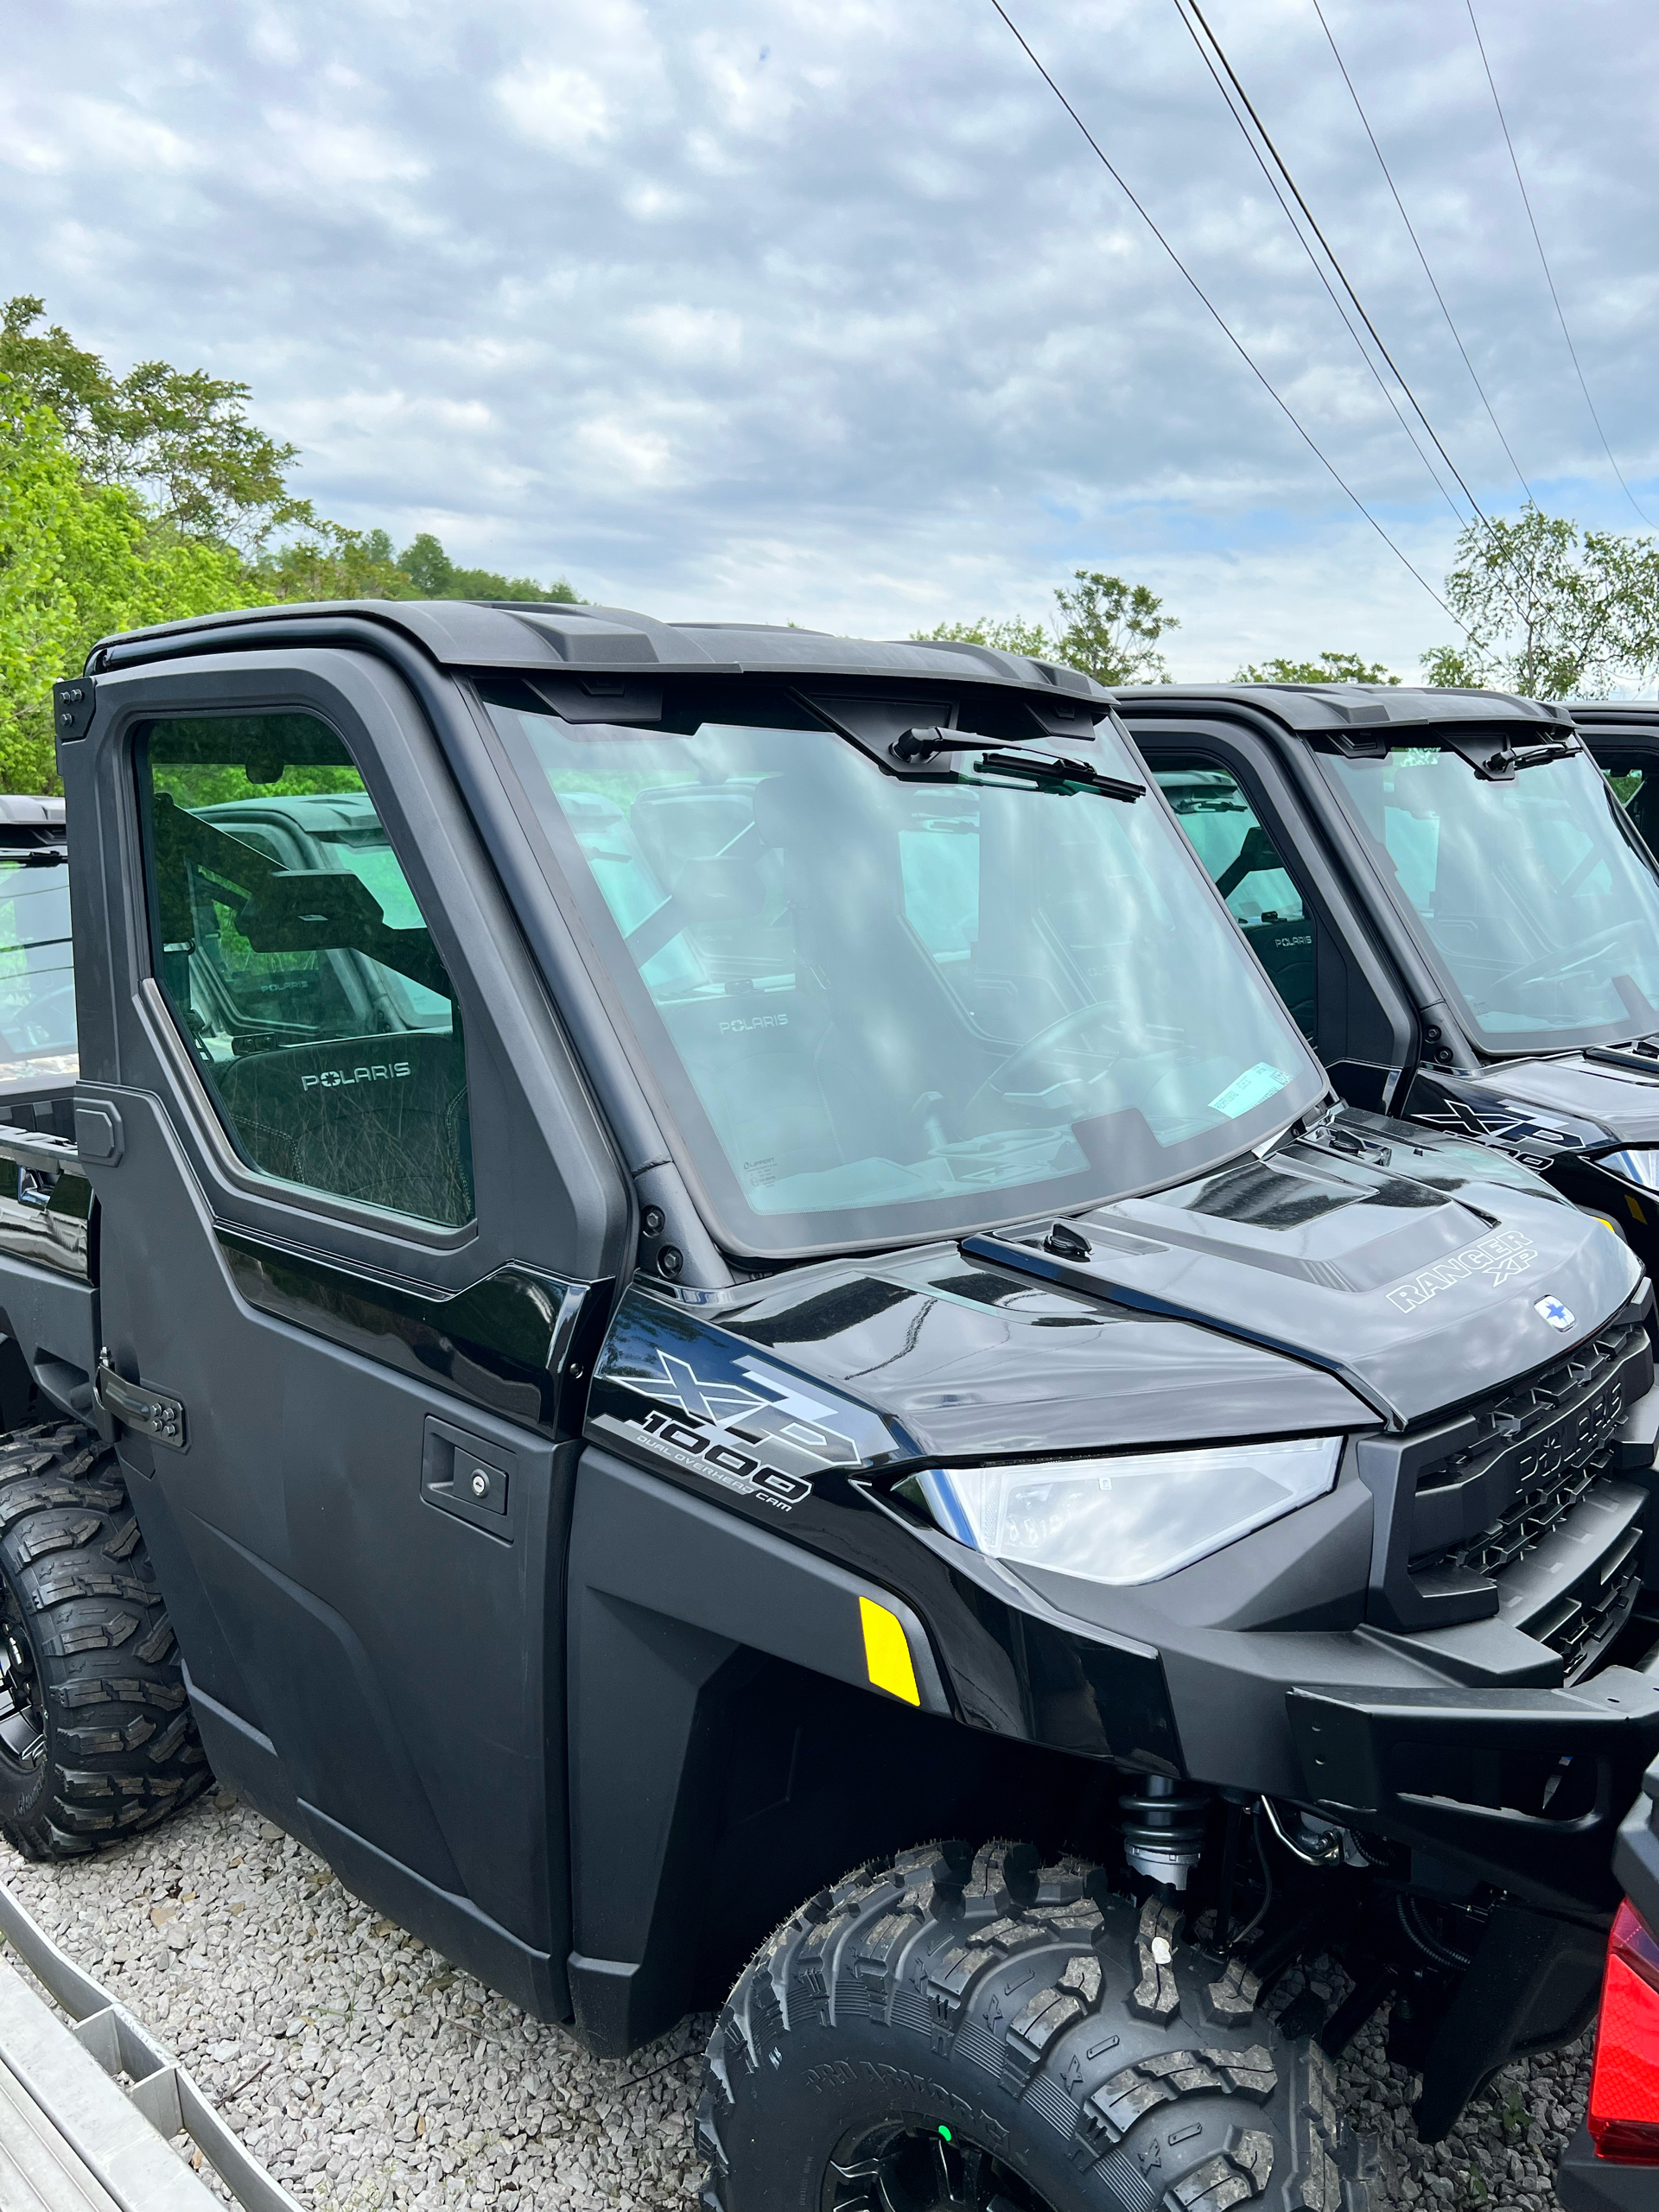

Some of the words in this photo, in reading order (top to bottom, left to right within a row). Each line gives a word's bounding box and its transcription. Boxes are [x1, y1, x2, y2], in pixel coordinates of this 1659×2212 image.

[1274, 936, 1313, 948] POLARIS
[719, 1014, 788, 1034] POLARIS
[301, 1062, 411, 1091] POLARIS
[1385, 1230, 1534, 1313] RANGER
[1482, 1249, 1538, 1288] XP
[606, 1349, 862, 1465] XP
[1515, 1379, 1623, 1495] POLARIS
[636, 1434, 672, 1457] DUAL
[674, 1453, 755, 1494] OVERHEAD
[755, 1491, 793, 1512] CAM
[642, 1410, 815, 1504] 1000
